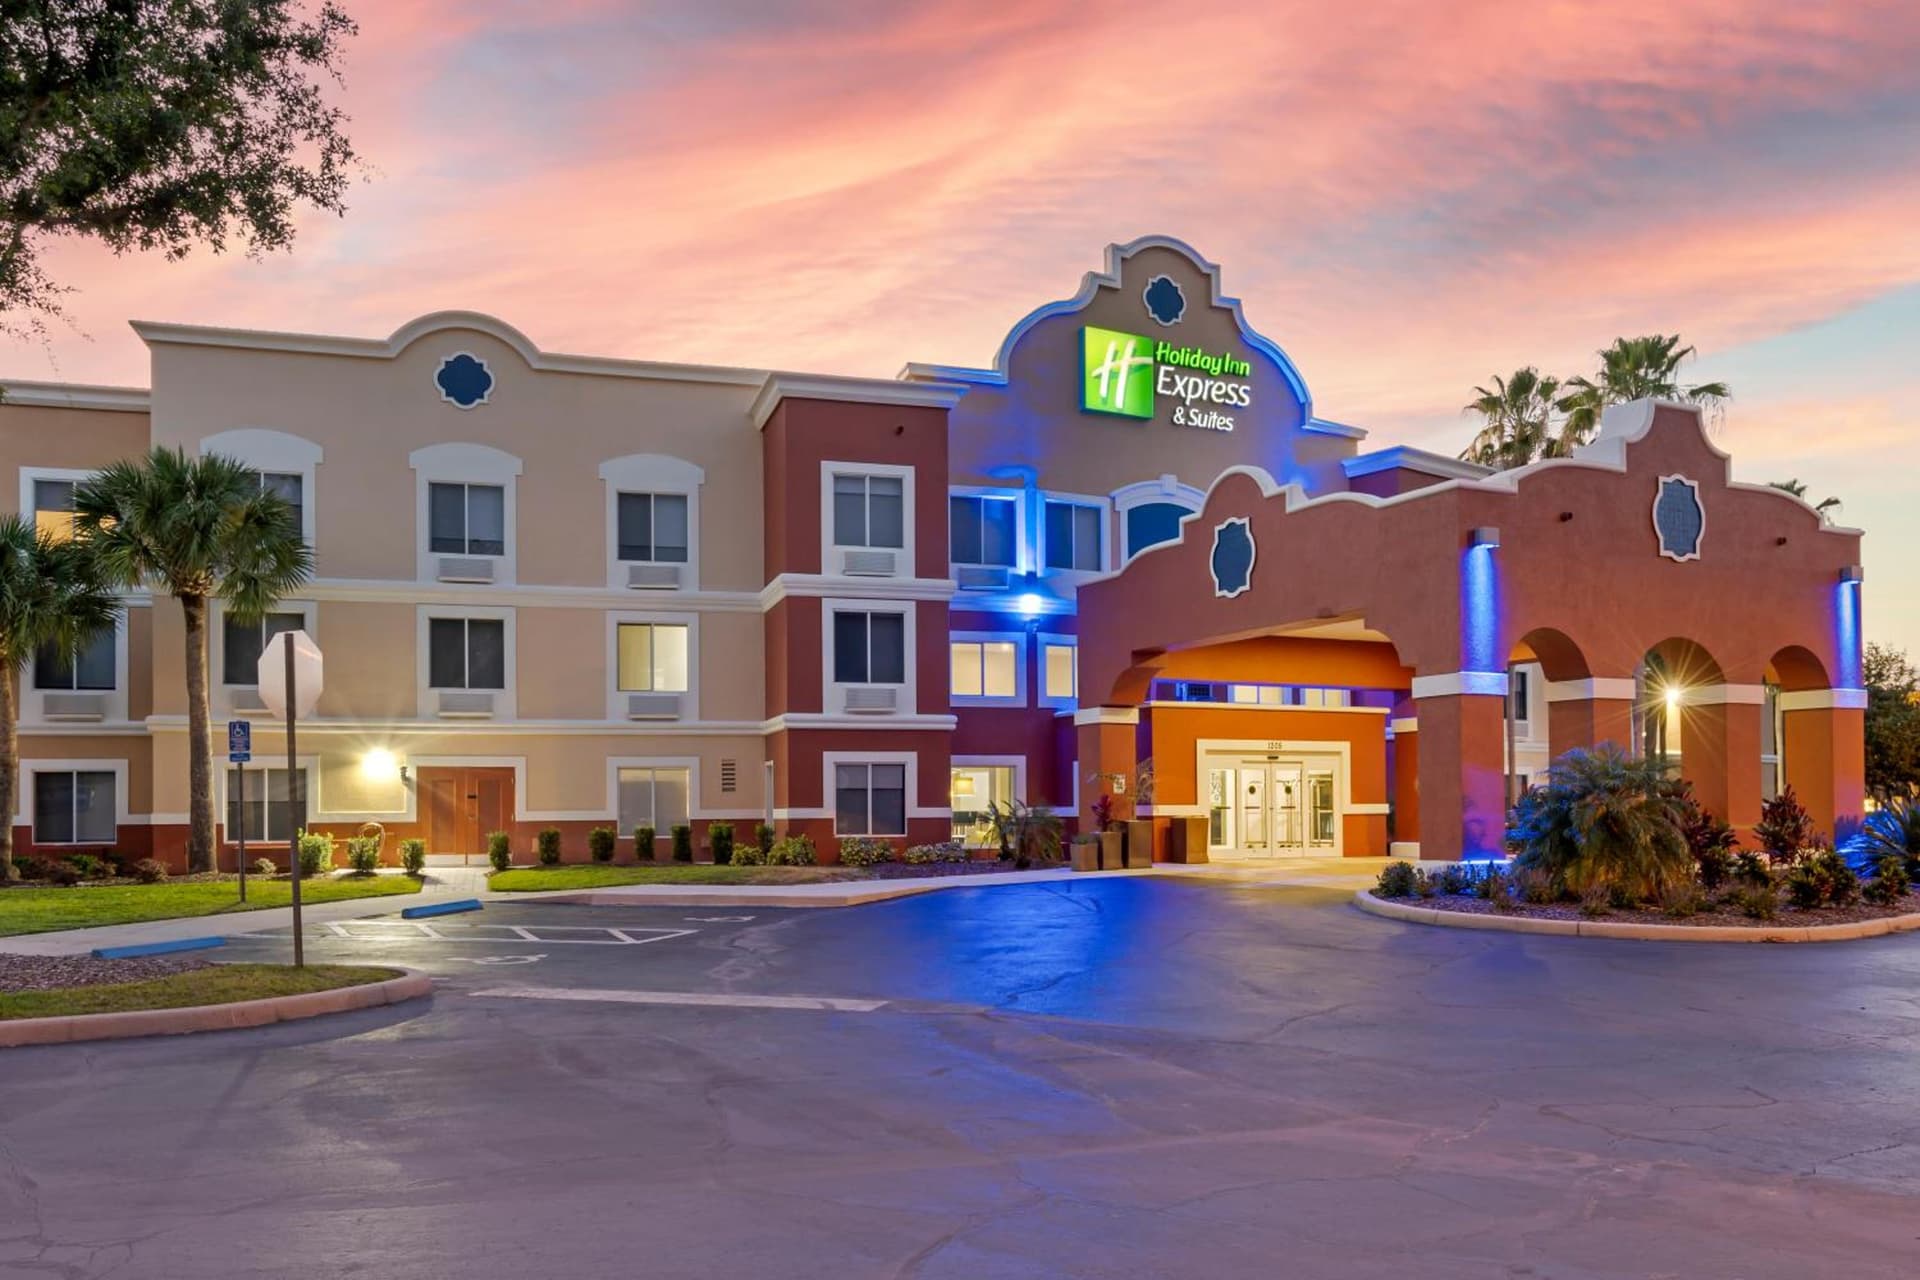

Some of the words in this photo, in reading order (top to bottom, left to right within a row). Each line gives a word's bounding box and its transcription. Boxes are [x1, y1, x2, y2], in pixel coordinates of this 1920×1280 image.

[1156, 341, 1222, 376] Holiday
[1224, 353, 1250, 377] Inn
[1156, 366, 1251, 407] Express
[1173, 406, 1185, 425] &
[1188, 408, 1234, 432] Suites
